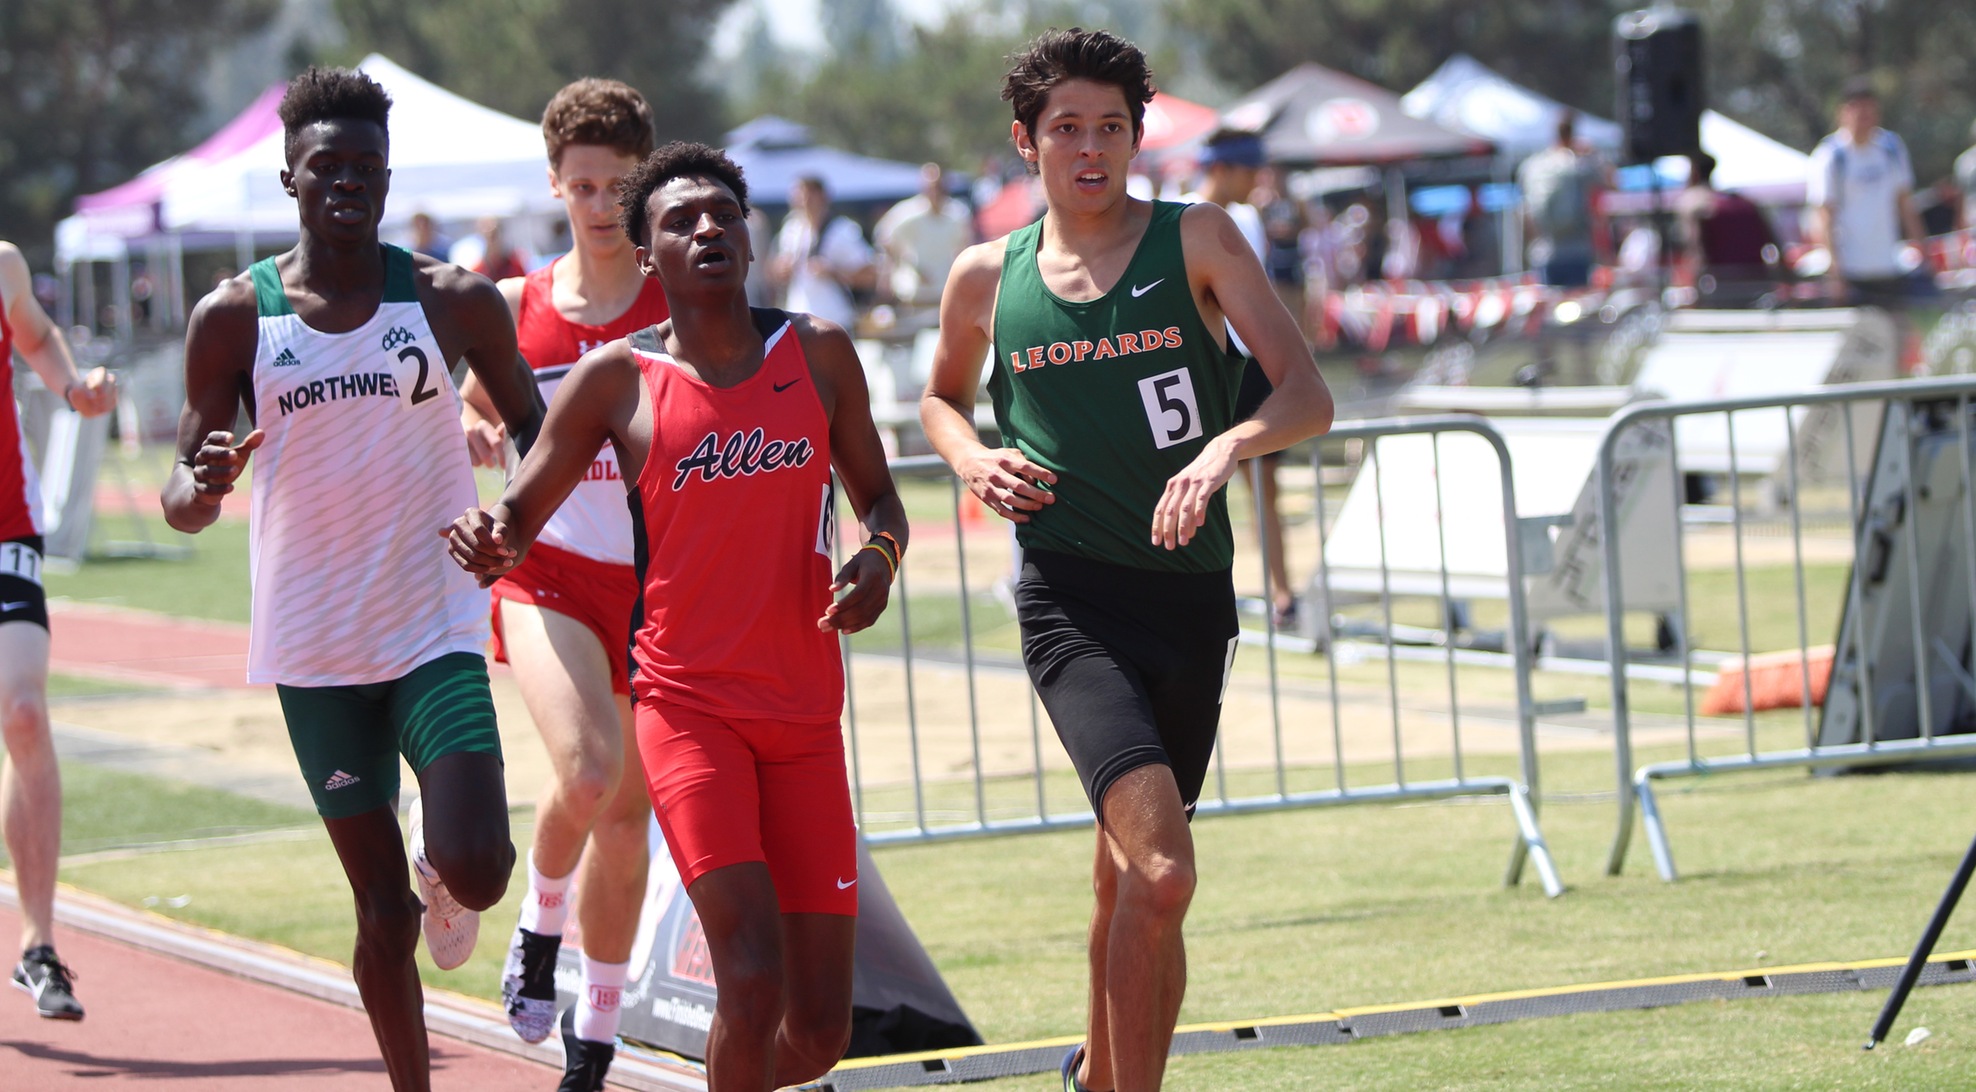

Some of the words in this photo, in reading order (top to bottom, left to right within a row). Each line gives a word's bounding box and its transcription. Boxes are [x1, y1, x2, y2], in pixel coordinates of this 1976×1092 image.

[397, 346, 438, 405] 2
[1011, 326, 1183, 374] LEOPARDS
[1153, 374, 1191, 441] 5
[672, 427, 815, 492] Allen
[9, 547, 37, 579] 11
[325, 776, 361, 790] adidas
